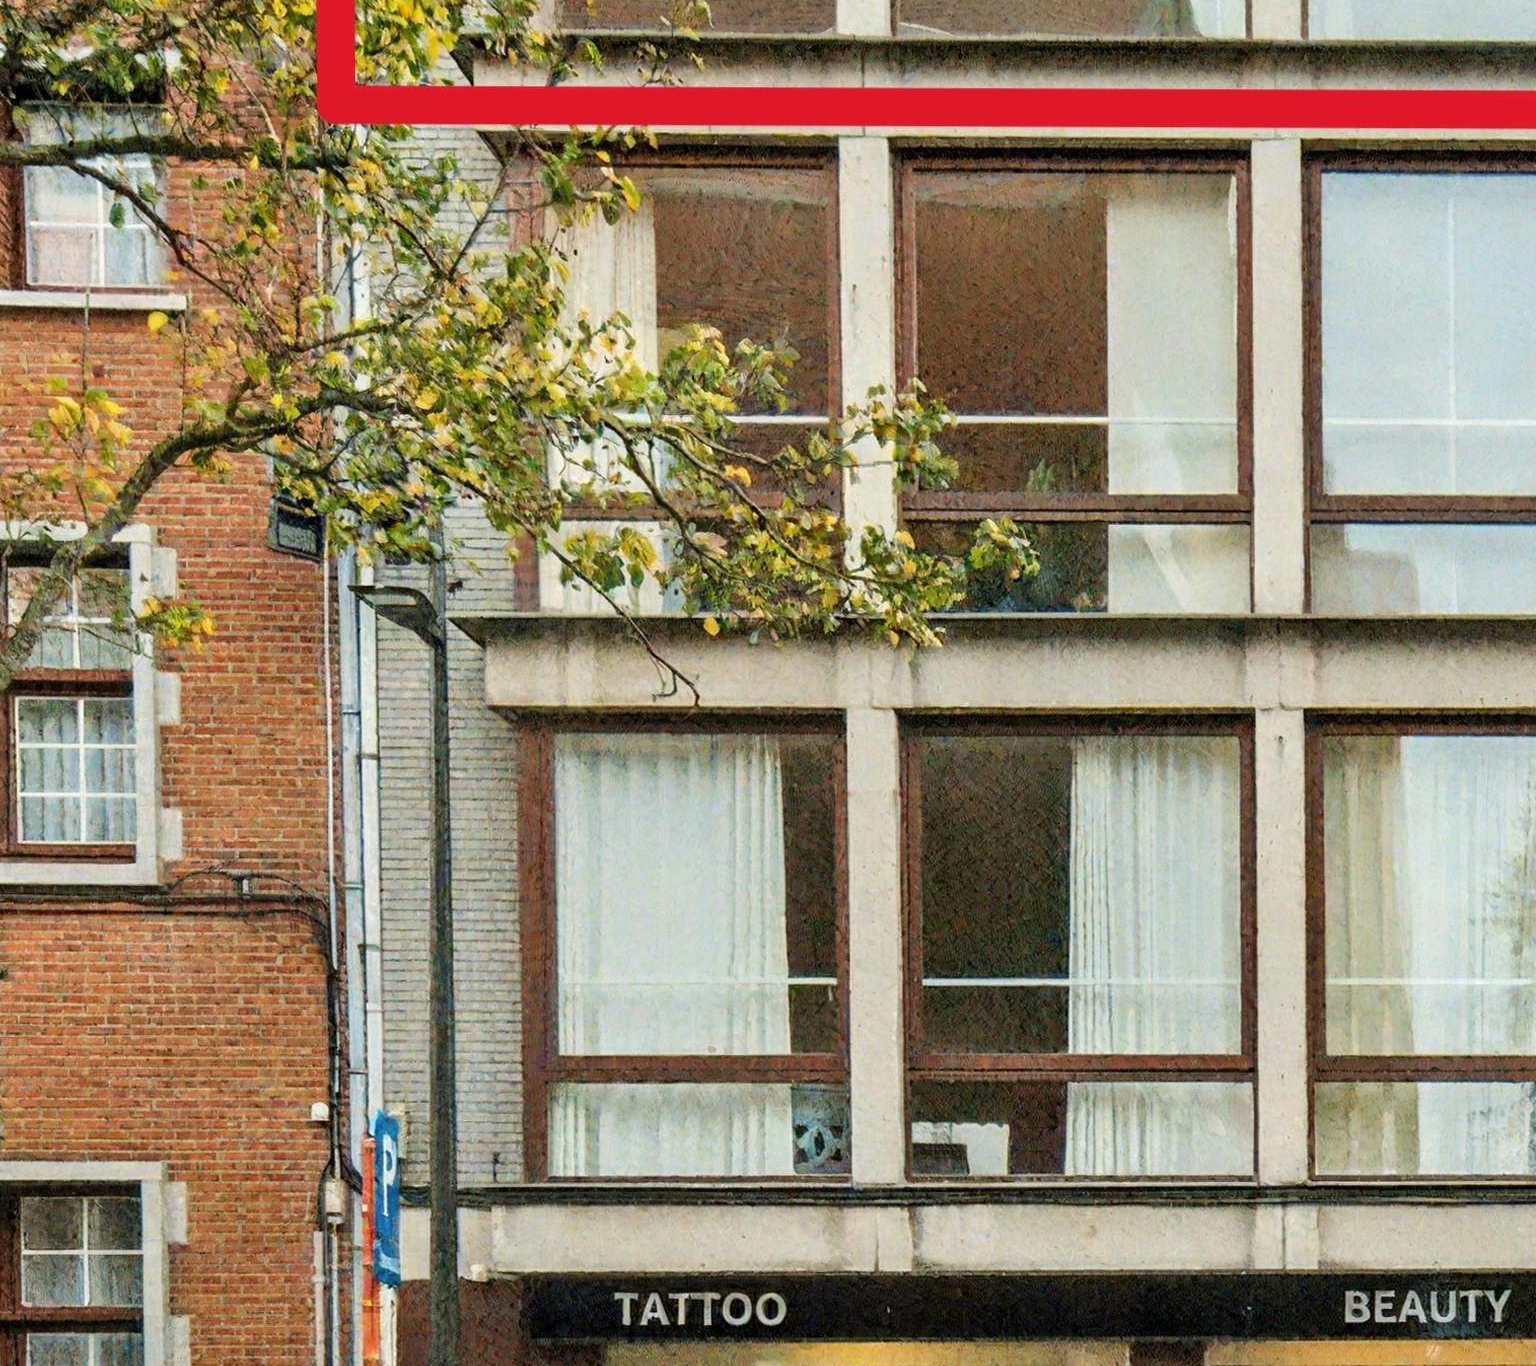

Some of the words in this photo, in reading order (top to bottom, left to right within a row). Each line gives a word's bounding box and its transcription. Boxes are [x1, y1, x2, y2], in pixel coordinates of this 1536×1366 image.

[382, 1133, 396, 1217] P
[613, 1291, 788, 1327] TATTOO
[1343, 1289, 1512, 1324] BEAUTY
